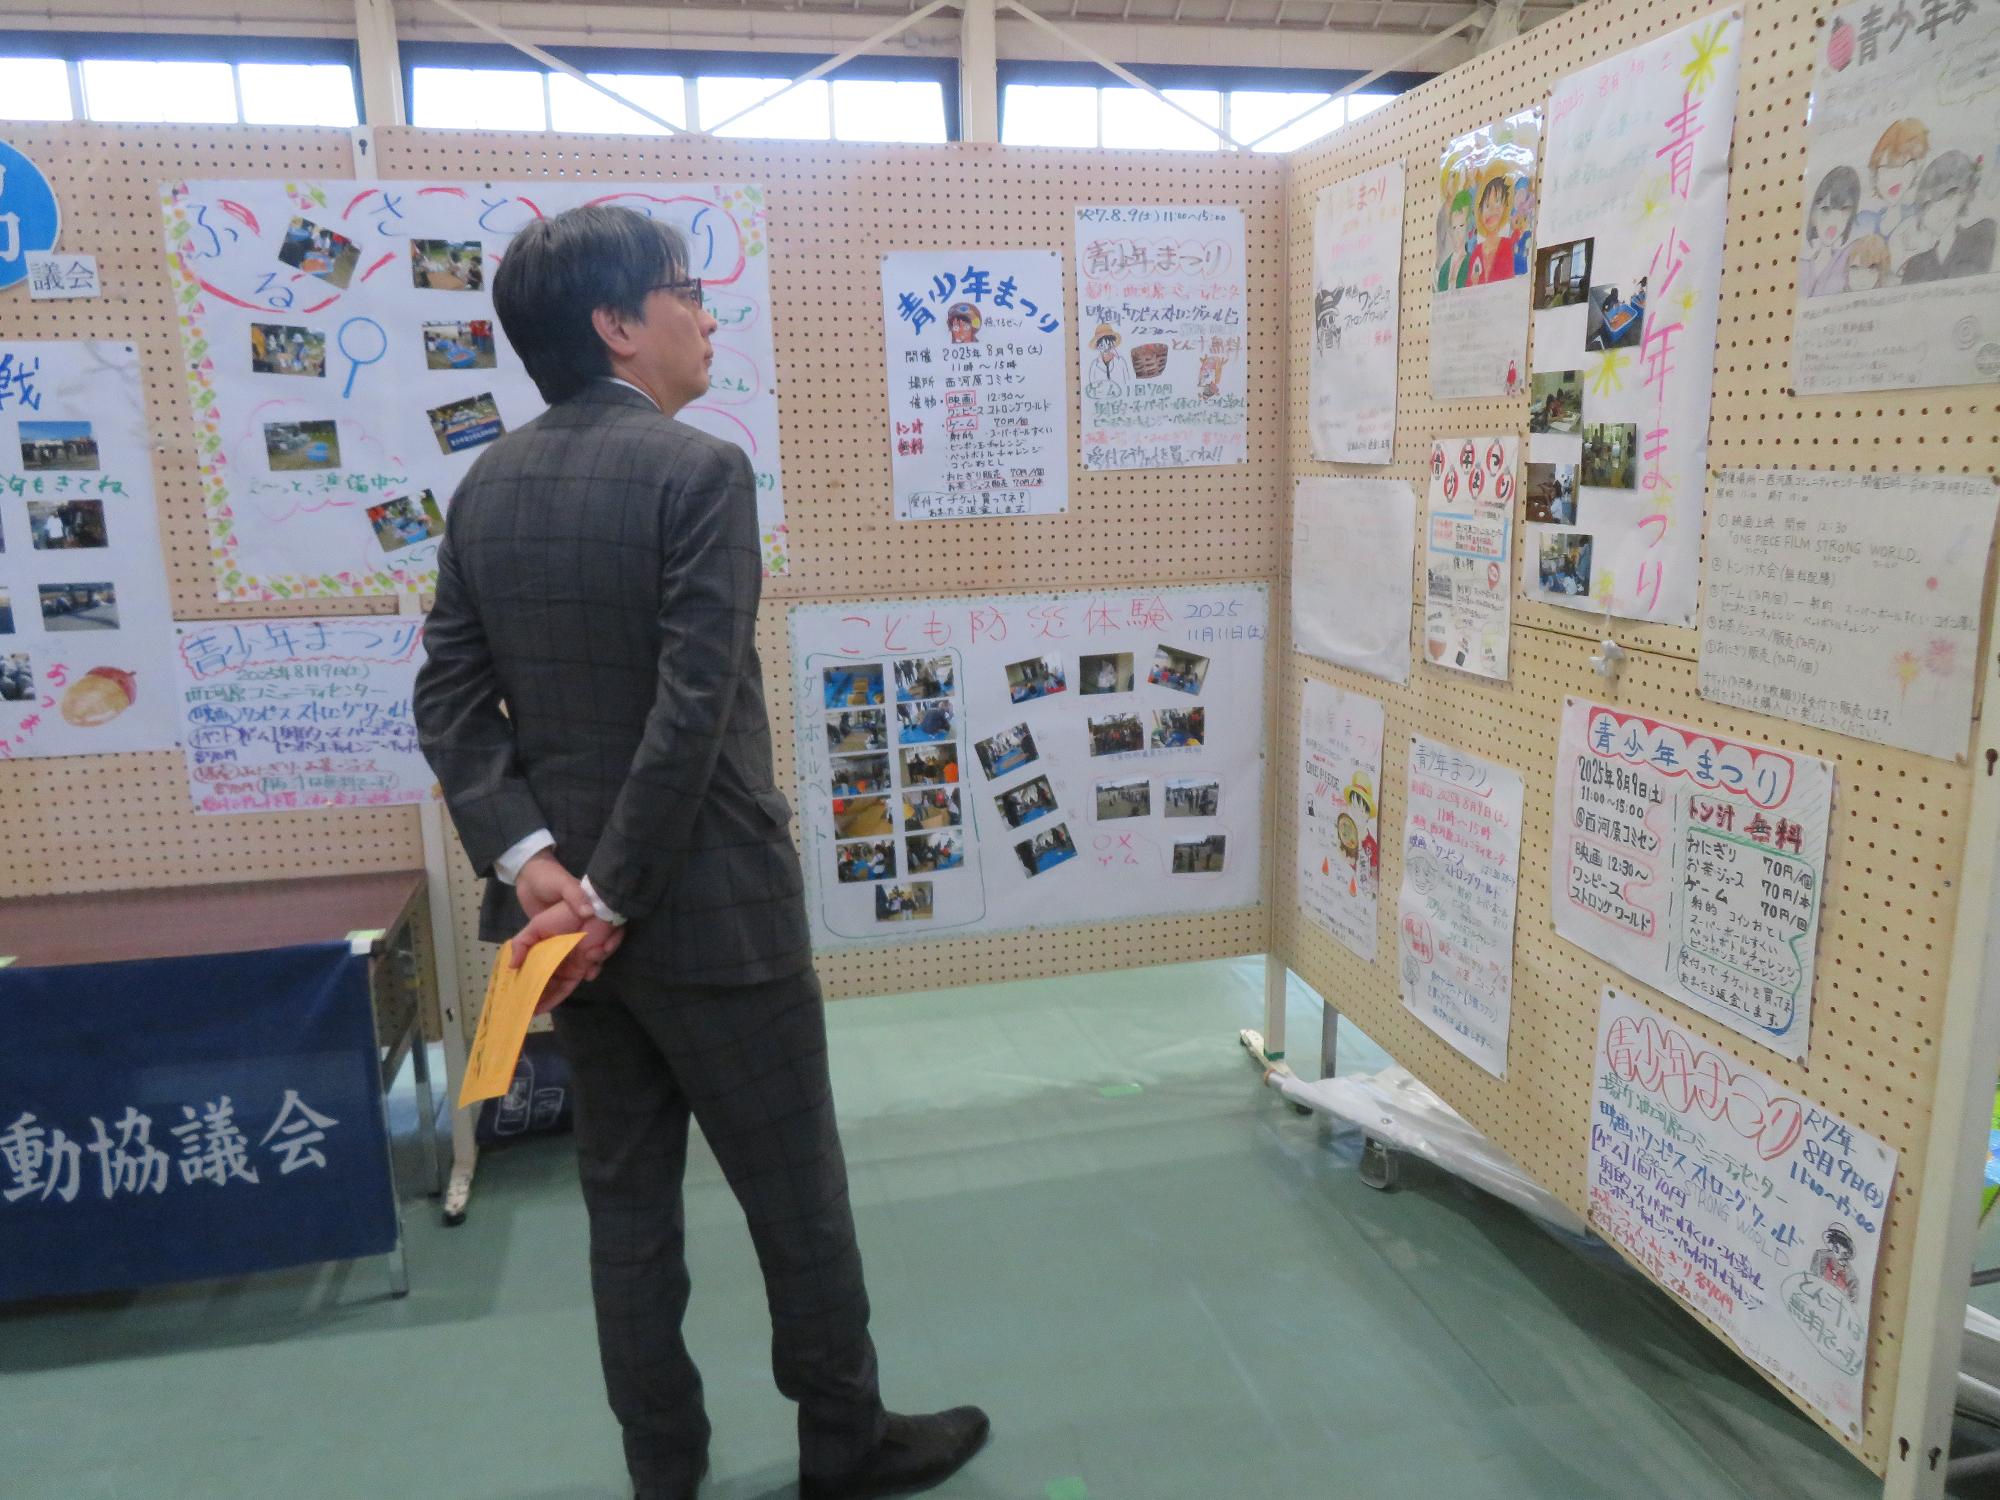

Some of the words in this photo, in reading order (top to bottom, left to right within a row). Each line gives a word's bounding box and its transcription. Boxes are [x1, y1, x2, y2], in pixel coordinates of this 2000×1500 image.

[1086, 240, 1222, 274] 青少年まつり
[31, 261, 94, 291] 議会
[897, 265, 1060, 336] 青少年まつり
[904, 349, 933, 364] 開催
[943, 347, 982, 362] 2025年
[986, 343, 1043, 358] 8月9日(土)
[1636, 92, 1706, 612] 青少年まつり
[907, 375, 936, 390] 場所
[945, 374, 1026, 388] 西河原コミセン
[947, 393, 975, 408] 映画
[897, 437, 924, 456] 無料
[840, 595, 1175, 655] こども防災体験
[1184, 602, 1243, 620] 2025
[187, 622, 416, 674] 青少年まつり
[1416, 744, 1487, 788] 青少年まつり
[1594, 715, 1777, 805] 青少年まつり
[1688, 798, 1735, 832] トン汁
[1743, 811, 1804, 855] 無料
[1574, 841, 1602, 868] 映画
[1687, 835, 1737, 863] おにぎり
[1572, 865, 1624, 901] ワンピース
[1690, 894, 1718, 916] 射的
[1610, 1019, 1801, 1153] 青少年まつり
[0, 1090, 340, 1203] 動協議会
